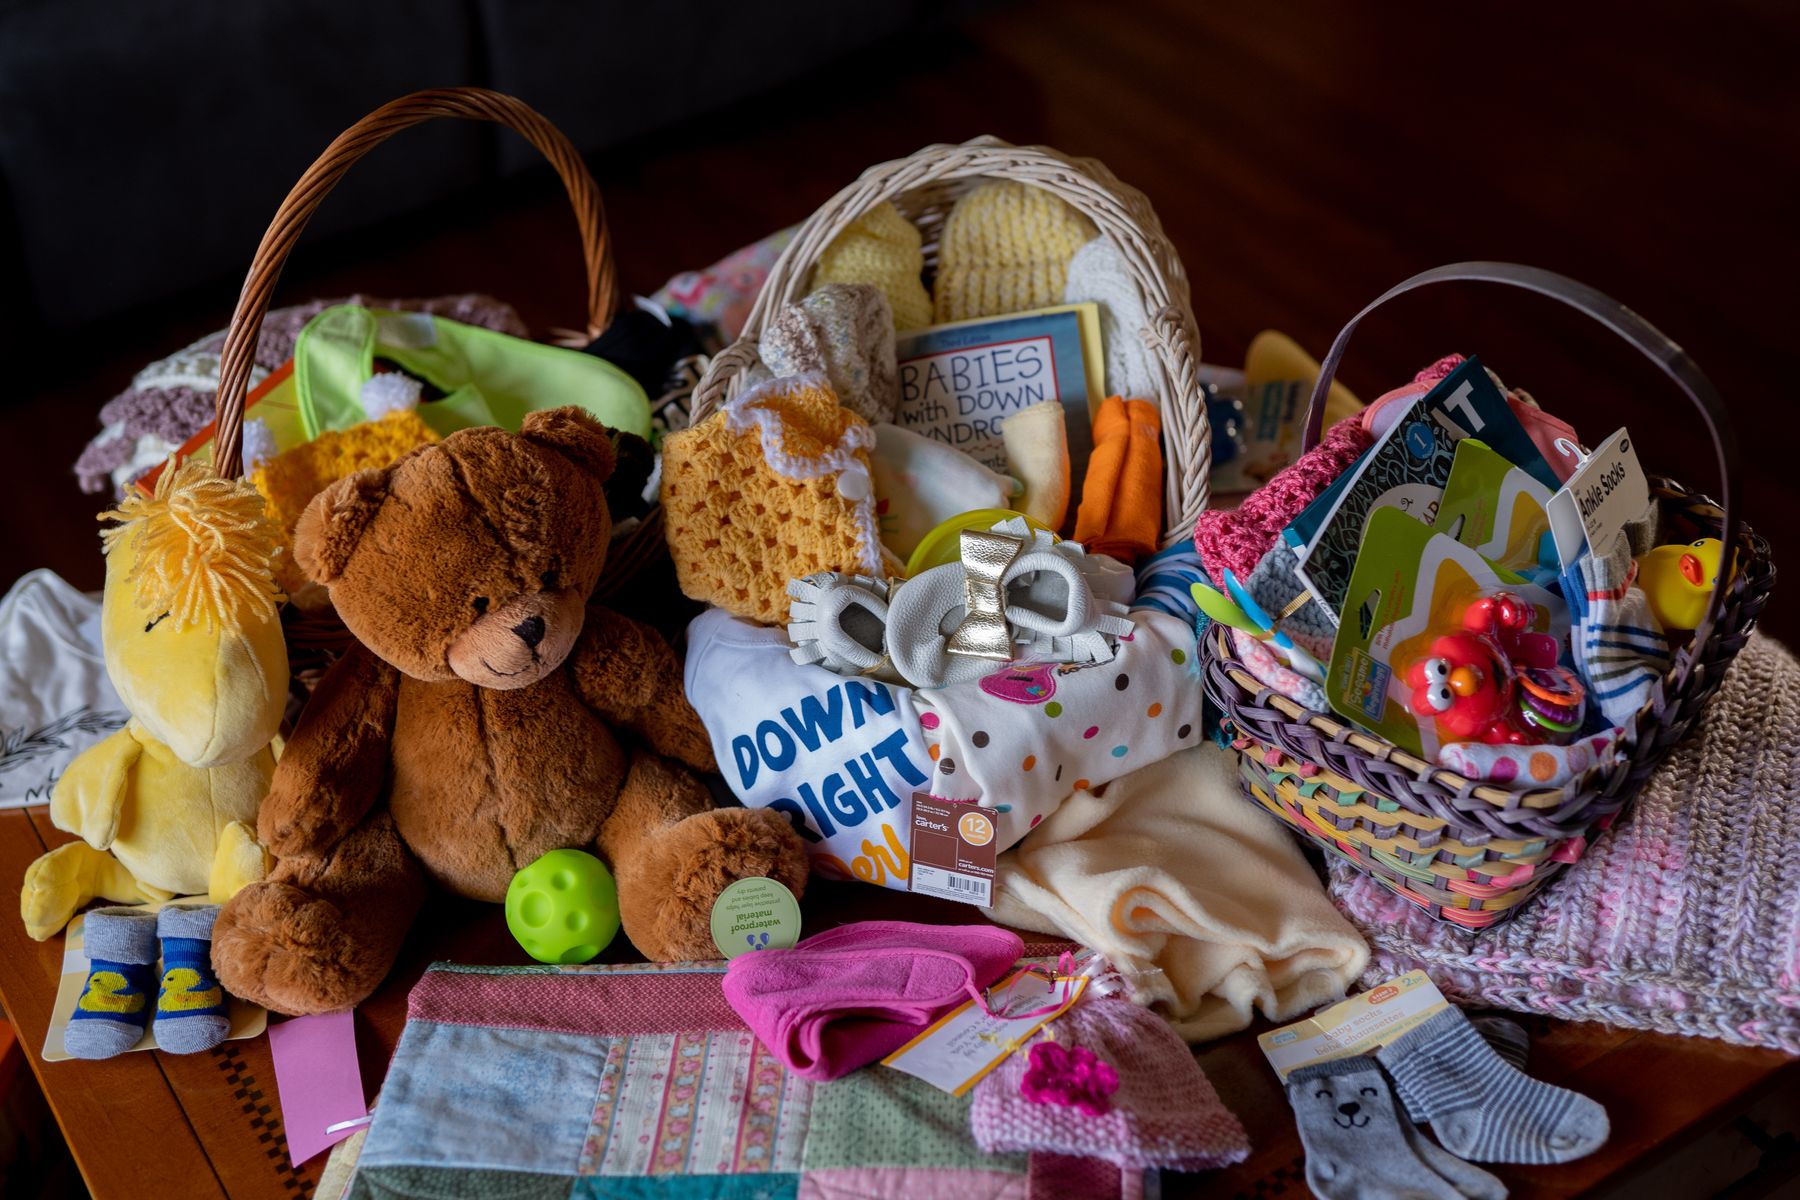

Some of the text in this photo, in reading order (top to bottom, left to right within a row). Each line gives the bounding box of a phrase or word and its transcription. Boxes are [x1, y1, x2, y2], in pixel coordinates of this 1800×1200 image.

[901, 345, 1043, 402] BABIES
[903, 382, 1045, 425] with DOWN
[1578, 484, 1605, 521] Ankle
[1599, 461, 1626, 496] Socks
[731, 681, 896, 790] DOWN
[915, 818, 986, 835] carter's 12
[730, 919, 781, 935] waterproof
[736, 909, 773, 923] material
[1353, 1009, 1384, 1027] socks
